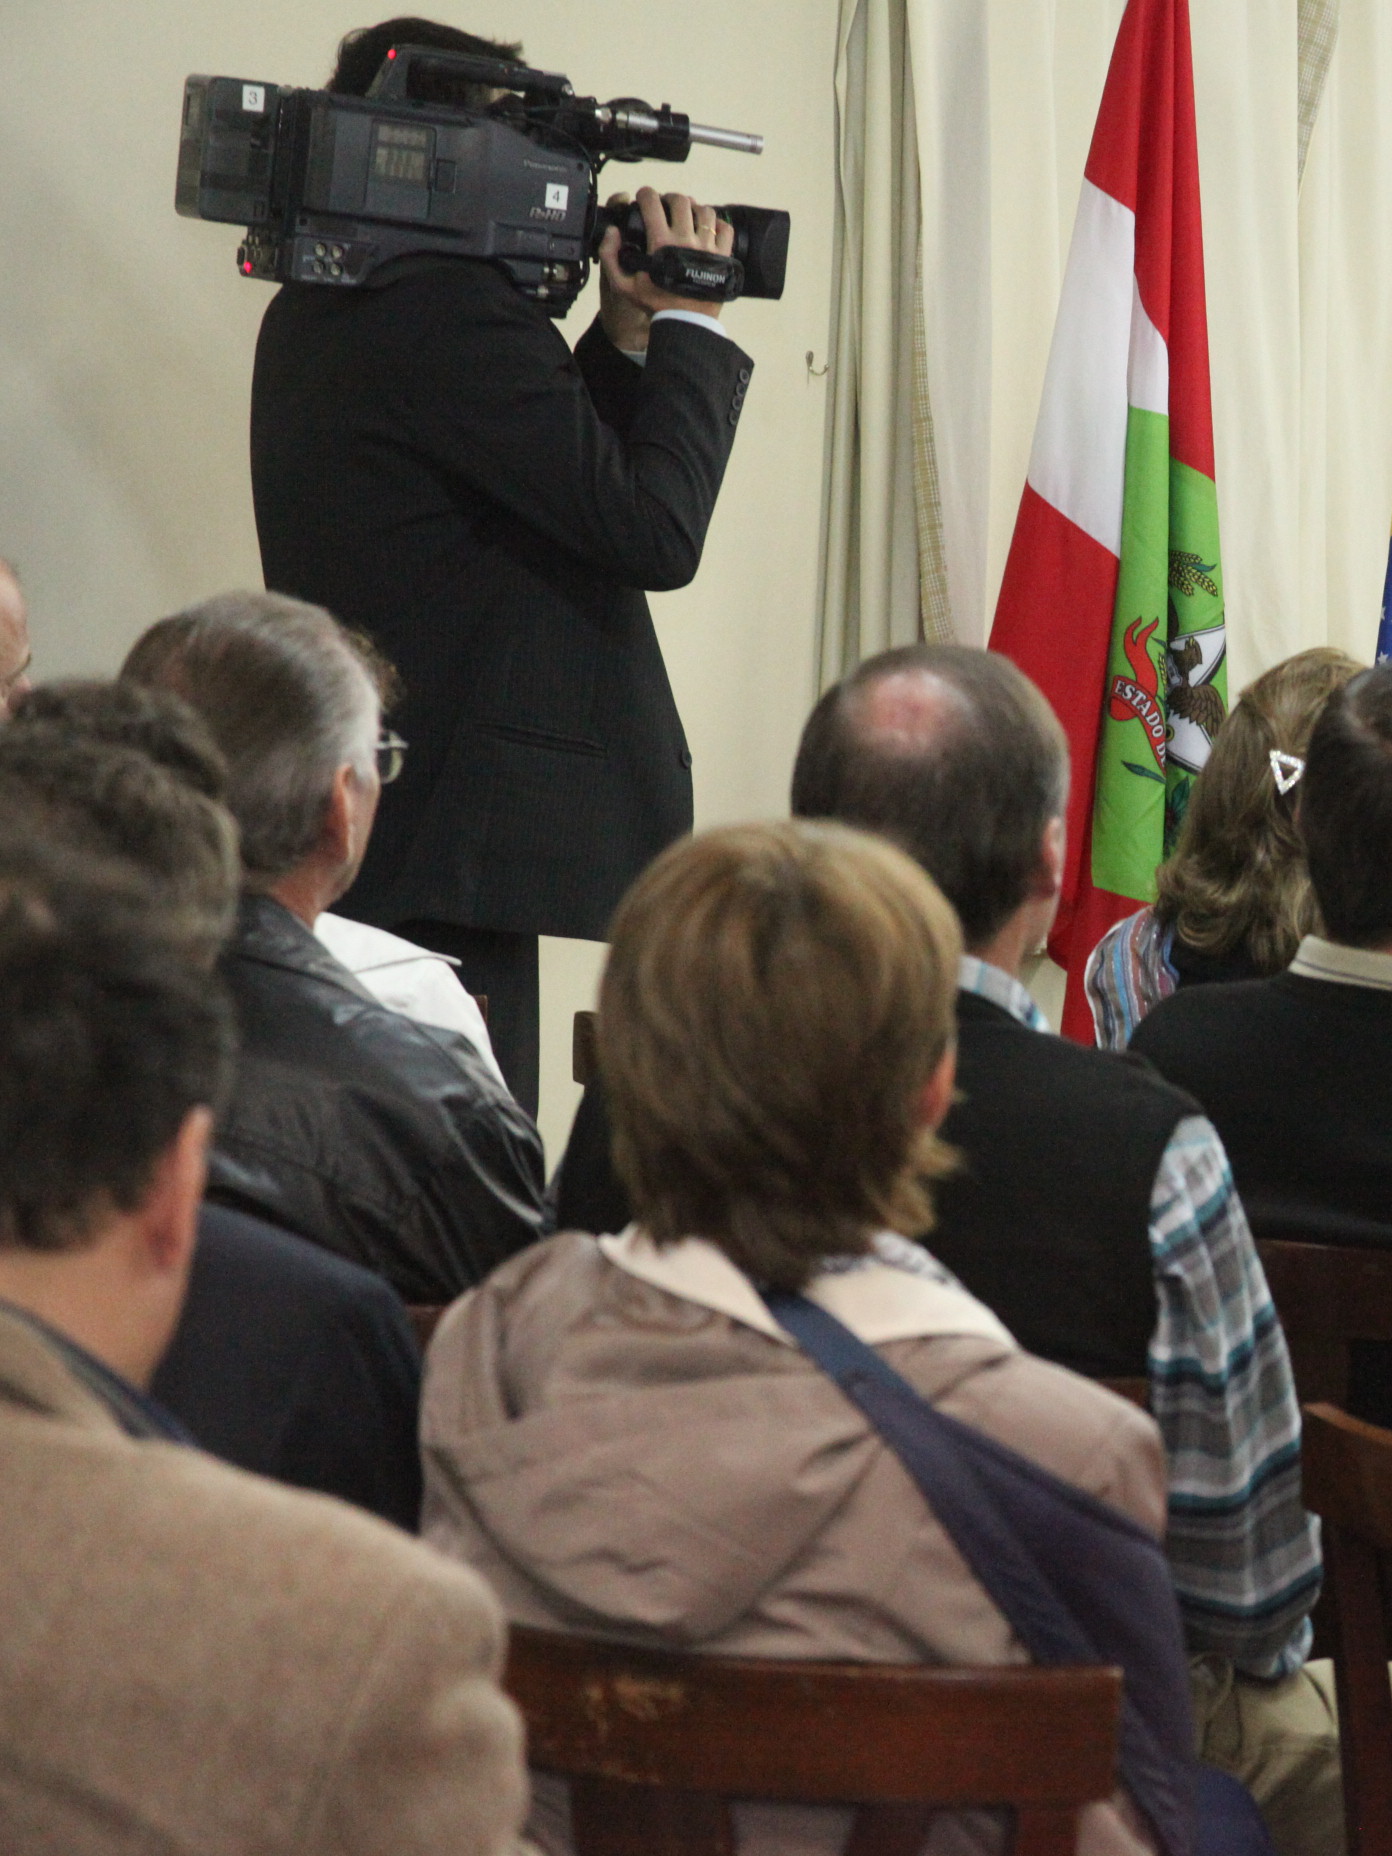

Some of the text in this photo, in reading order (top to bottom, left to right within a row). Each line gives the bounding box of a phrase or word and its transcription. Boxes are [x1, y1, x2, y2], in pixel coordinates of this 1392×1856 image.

[248, 90, 258, 106] 3
[552, 190, 561, 203] 4
[685, 268, 726, 284] FUJINON
[1114, 680, 1164, 738] ESTADO
